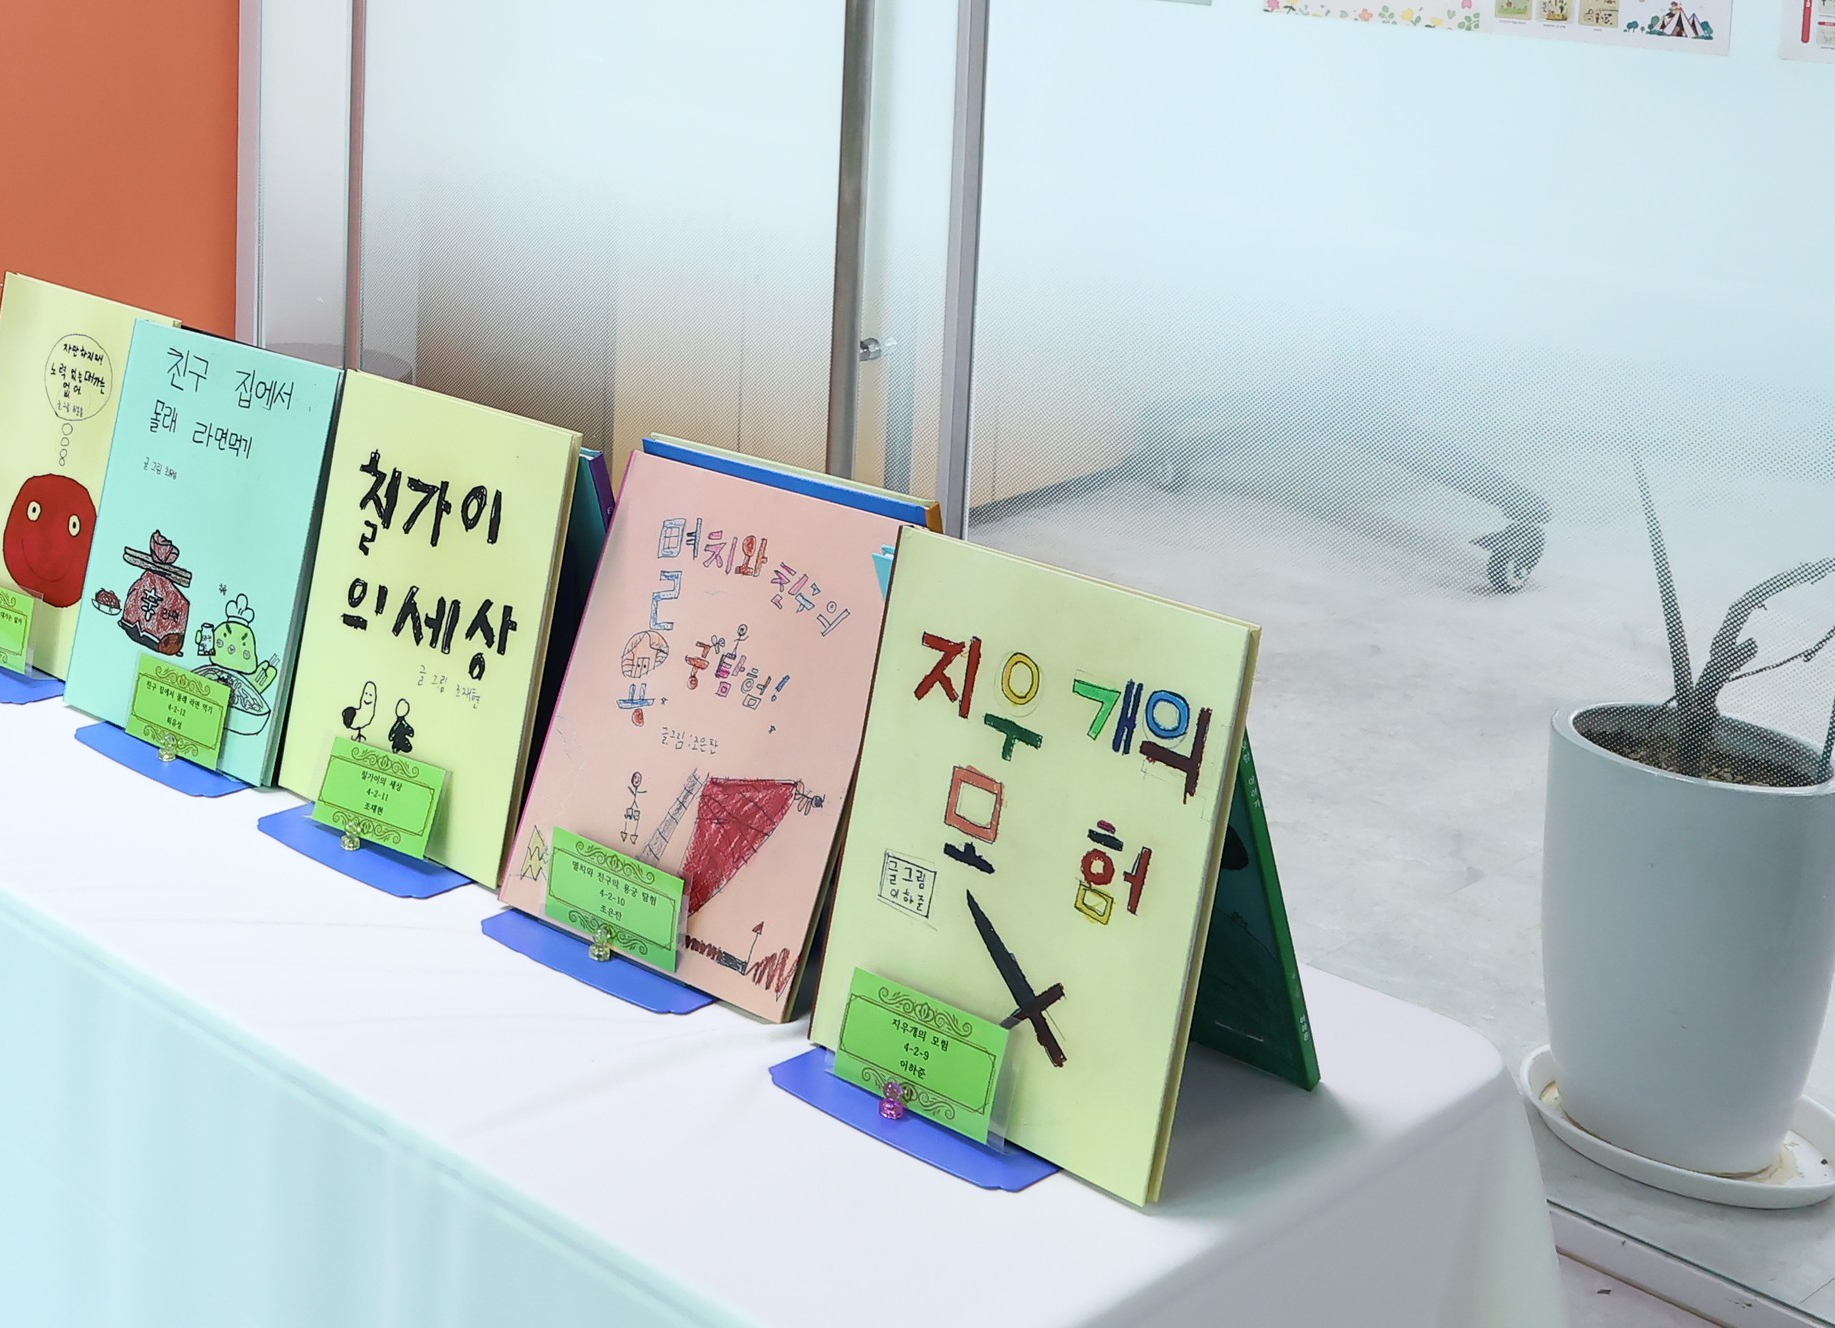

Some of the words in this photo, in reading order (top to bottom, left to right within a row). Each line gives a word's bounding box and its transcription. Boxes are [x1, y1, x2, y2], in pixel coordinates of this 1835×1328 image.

[50, 362, 67, 380] 노력
[167, 347, 209, 392] 친구
[235, 369, 295, 410] 집에서
[150, 399, 178, 433] 몰래
[359, 449, 503, 556] 칠가이
[167, 704, 186, 717] 4-2-12
[361, 770, 387, 787] 칠가이의
[389, 780, 403, 792] 세상
[366, 788, 389, 802] 4-2-11
[572, 860, 594, 878] 멸치와
[597, 872, 620, 889] 친구의
[623, 883, 638, 898] 용궁
[642, 892, 657, 906] 탐험
[888, 860, 899, 885] 글
[902, 867, 926, 890] 그림
[600, 889, 626, 906] 4-2-10
[890, 888, 925, 912] 이하준
[600, 905, 622, 921] 조은찬
[891, 1018, 927, 1042] 지우개의
[930, 1034, 950, 1052] 모험
[903, 1041, 930, 1061] 4-2-9
[899, 1060, 927, 1081] 이하준
